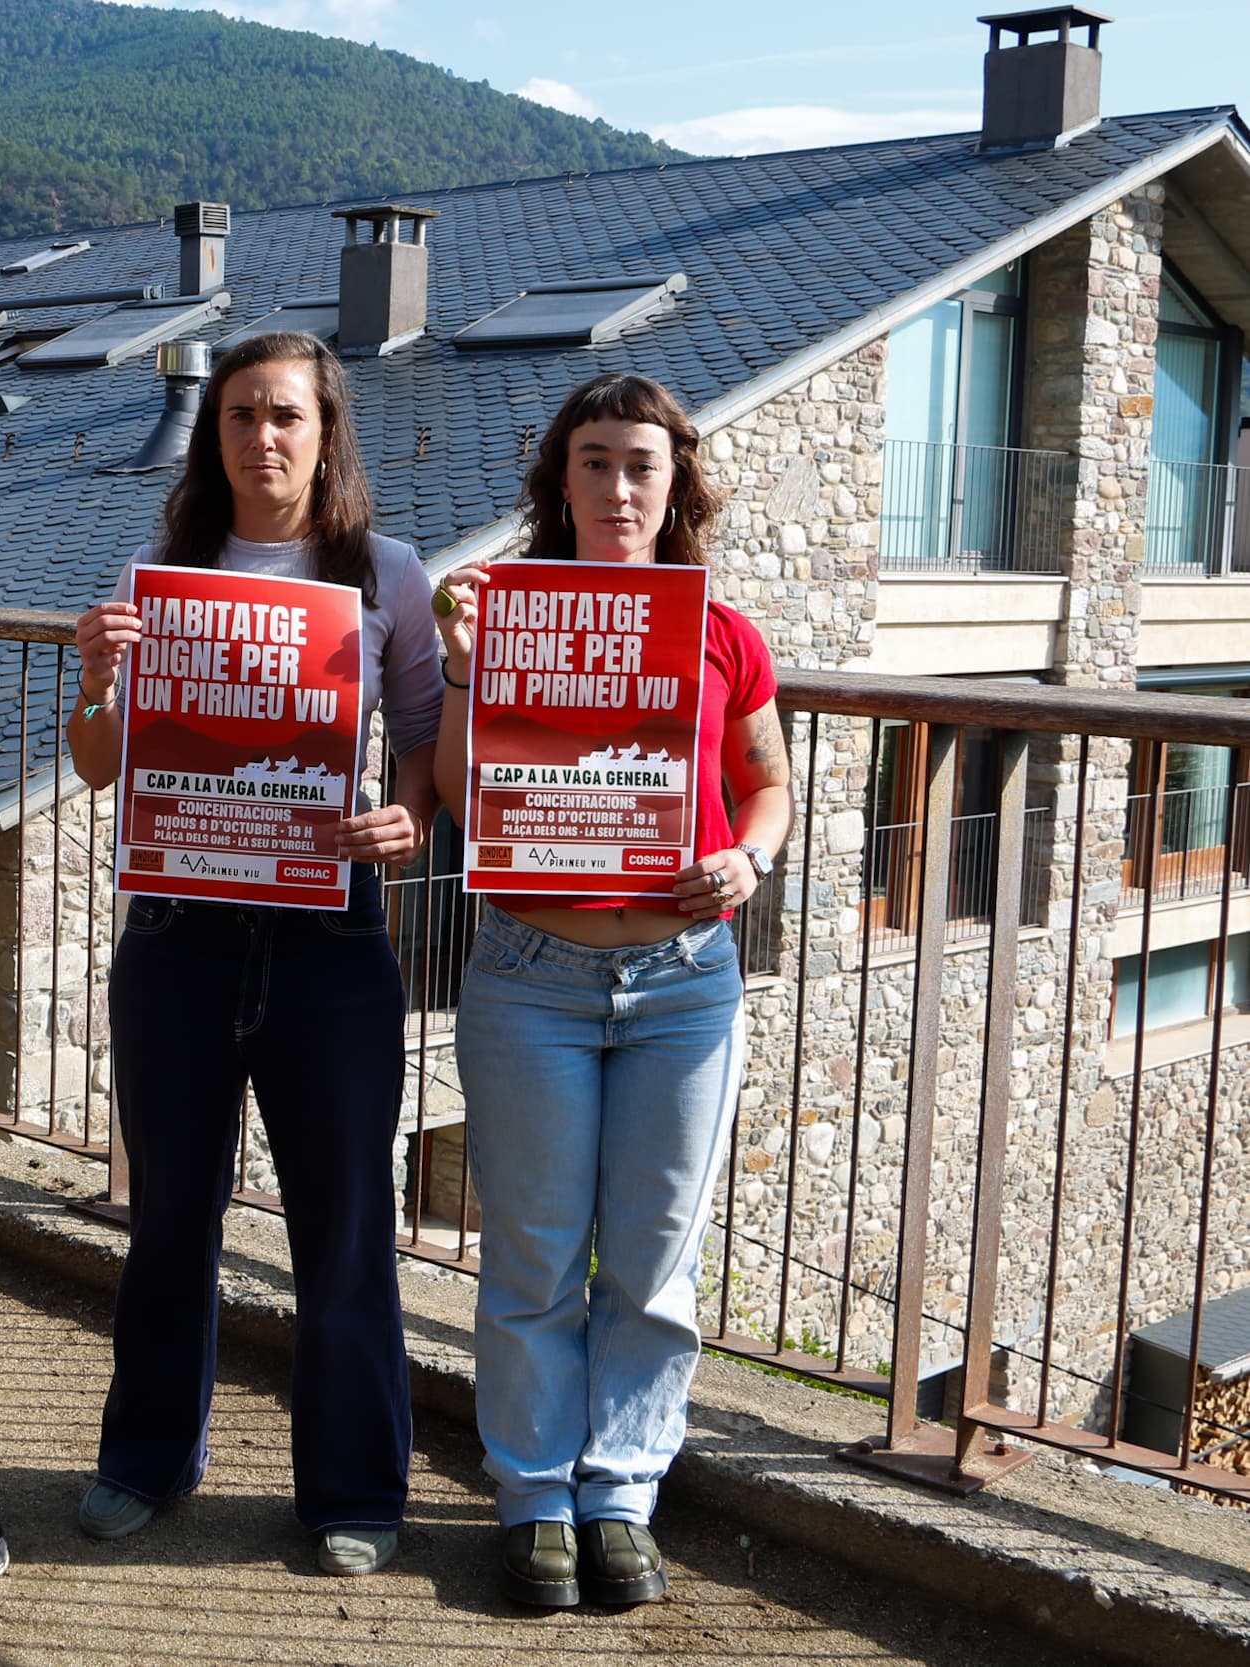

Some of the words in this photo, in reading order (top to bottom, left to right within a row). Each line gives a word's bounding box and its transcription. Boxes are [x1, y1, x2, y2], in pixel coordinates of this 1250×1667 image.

[141, 596, 307, 646] HABITATGE
[485, 589, 650, 633] HABITATGE
[139, 637, 231, 681] DIGNE
[240, 643, 299, 685] PER
[483, 631, 574, 672] DIGNE
[584, 633, 642, 674] PER
[137, 677, 171, 712] UN
[181, 680, 285, 720] PIRINEU
[294, 688, 337, 724] VIU
[481, 672, 516, 705] UN
[525, 673, 627, 708] PIRINEU
[637, 676, 679, 710] VIU
[147, 773, 176, 789] CAP
[181, 776, 190, 791] A
[195, 777, 211, 792] LA
[216, 779, 256, 796] VAGA
[261, 783, 326, 801] GENERAL
[494, 767, 523, 783] CAP
[528, 769, 536, 783] A
[542, 769, 558, 784] LA
[563, 770, 601, 785] VAGA
[606, 771, 669, 787] GENERAL
[178, 801, 292, 821] CONCENTRACIONS
[525, 793, 637, 809] CONCENTRACIONS
[155, 814, 196, 830] DIJOUS
[287, 826, 301, 838] 19
[304, 827, 313, 839] H
[503, 809, 544, 824] DIJOUS
[633, 813, 646, 824] 19
[649, 814, 656, 825] H
[154, 831, 184, 843] PLAÇA
[186, 832, 208, 844] DELS
[238, 836, 250, 847] LA
[251, 838, 271, 848] SEU
[502, 825, 532, 837] PLAÇA
[534, 826, 557, 836] DELS
[585, 827, 596, 837] LA
[598, 828, 616, 838] SEU
[479, 846, 513, 859] SINDICAT
[629, 855, 674, 865] COSHAC
[201, 865, 239, 877] PIRINEU
[244, 870, 260, 878] VIU
[550, 858, 585, 867] PIRINEU
[591, 859, 605, 868] VIU
[284, 867, 330, 880] COSHAC
